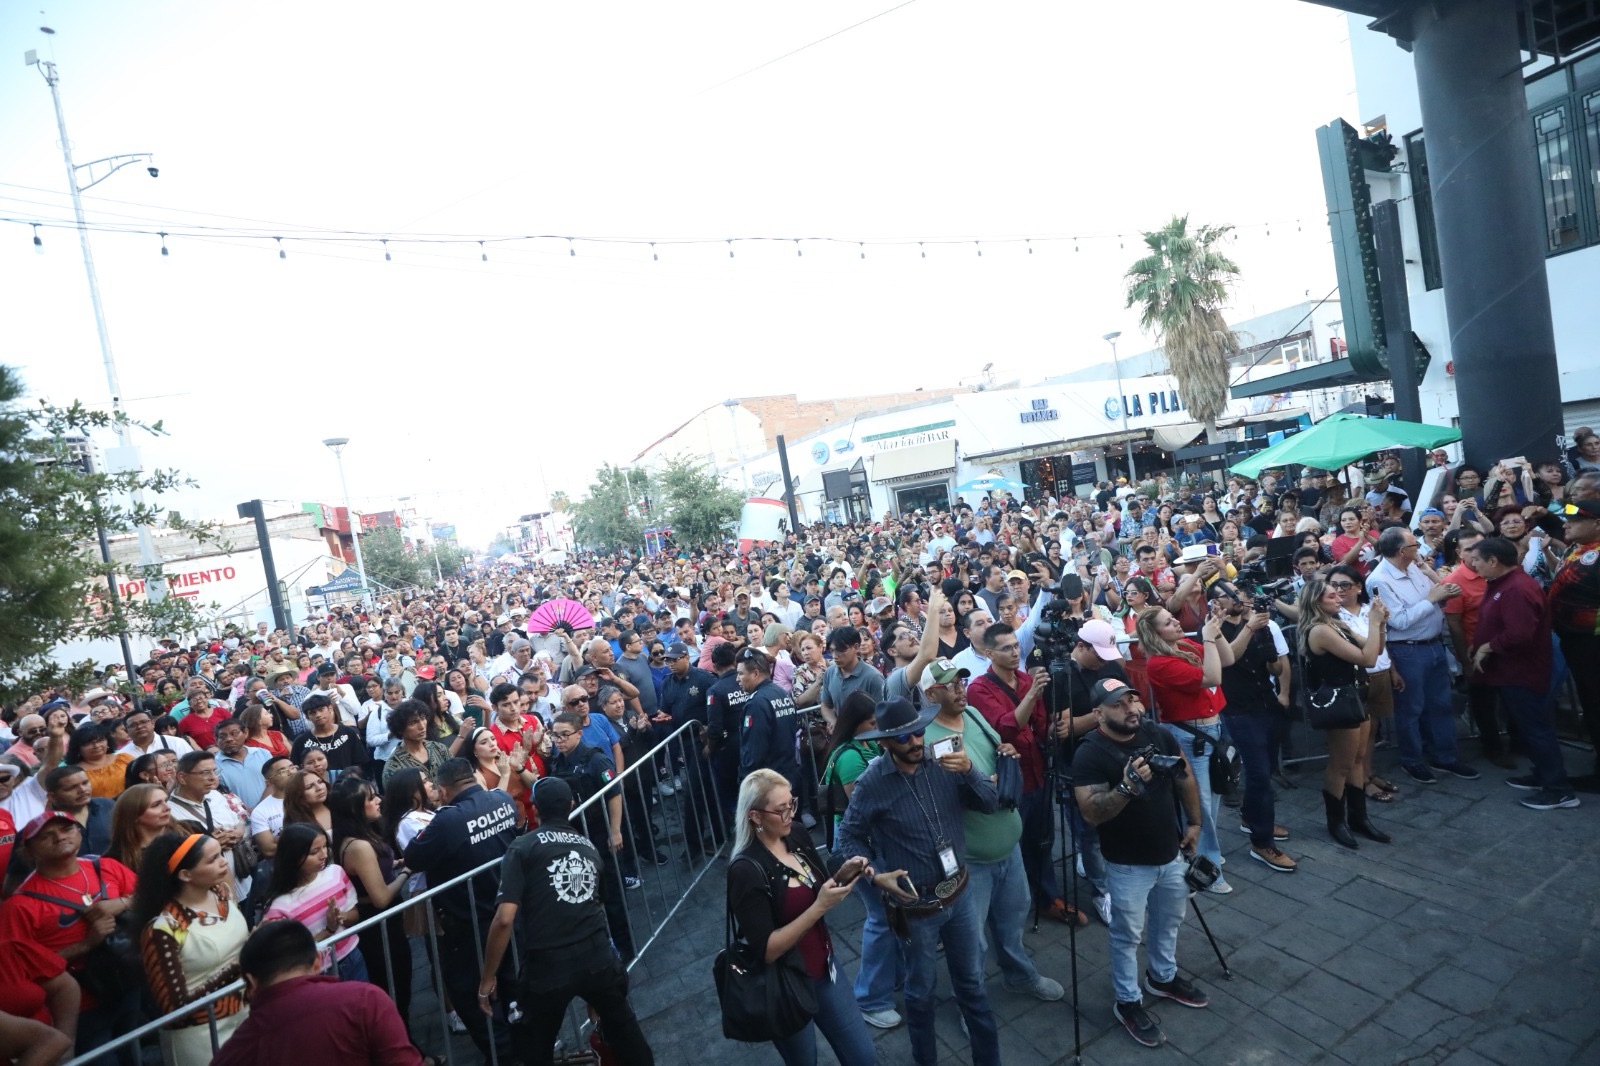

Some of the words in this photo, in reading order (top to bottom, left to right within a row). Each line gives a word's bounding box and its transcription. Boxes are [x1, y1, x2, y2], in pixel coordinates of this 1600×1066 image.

[1122, 394, 1143, 418] LA
[1148, 389, 1187, 416] PLA
[926, 430, 949, 442] BAR
[466, 802, 515, 834] POLICÍA
[470, 816, 516, 844] MUNICIPAL
